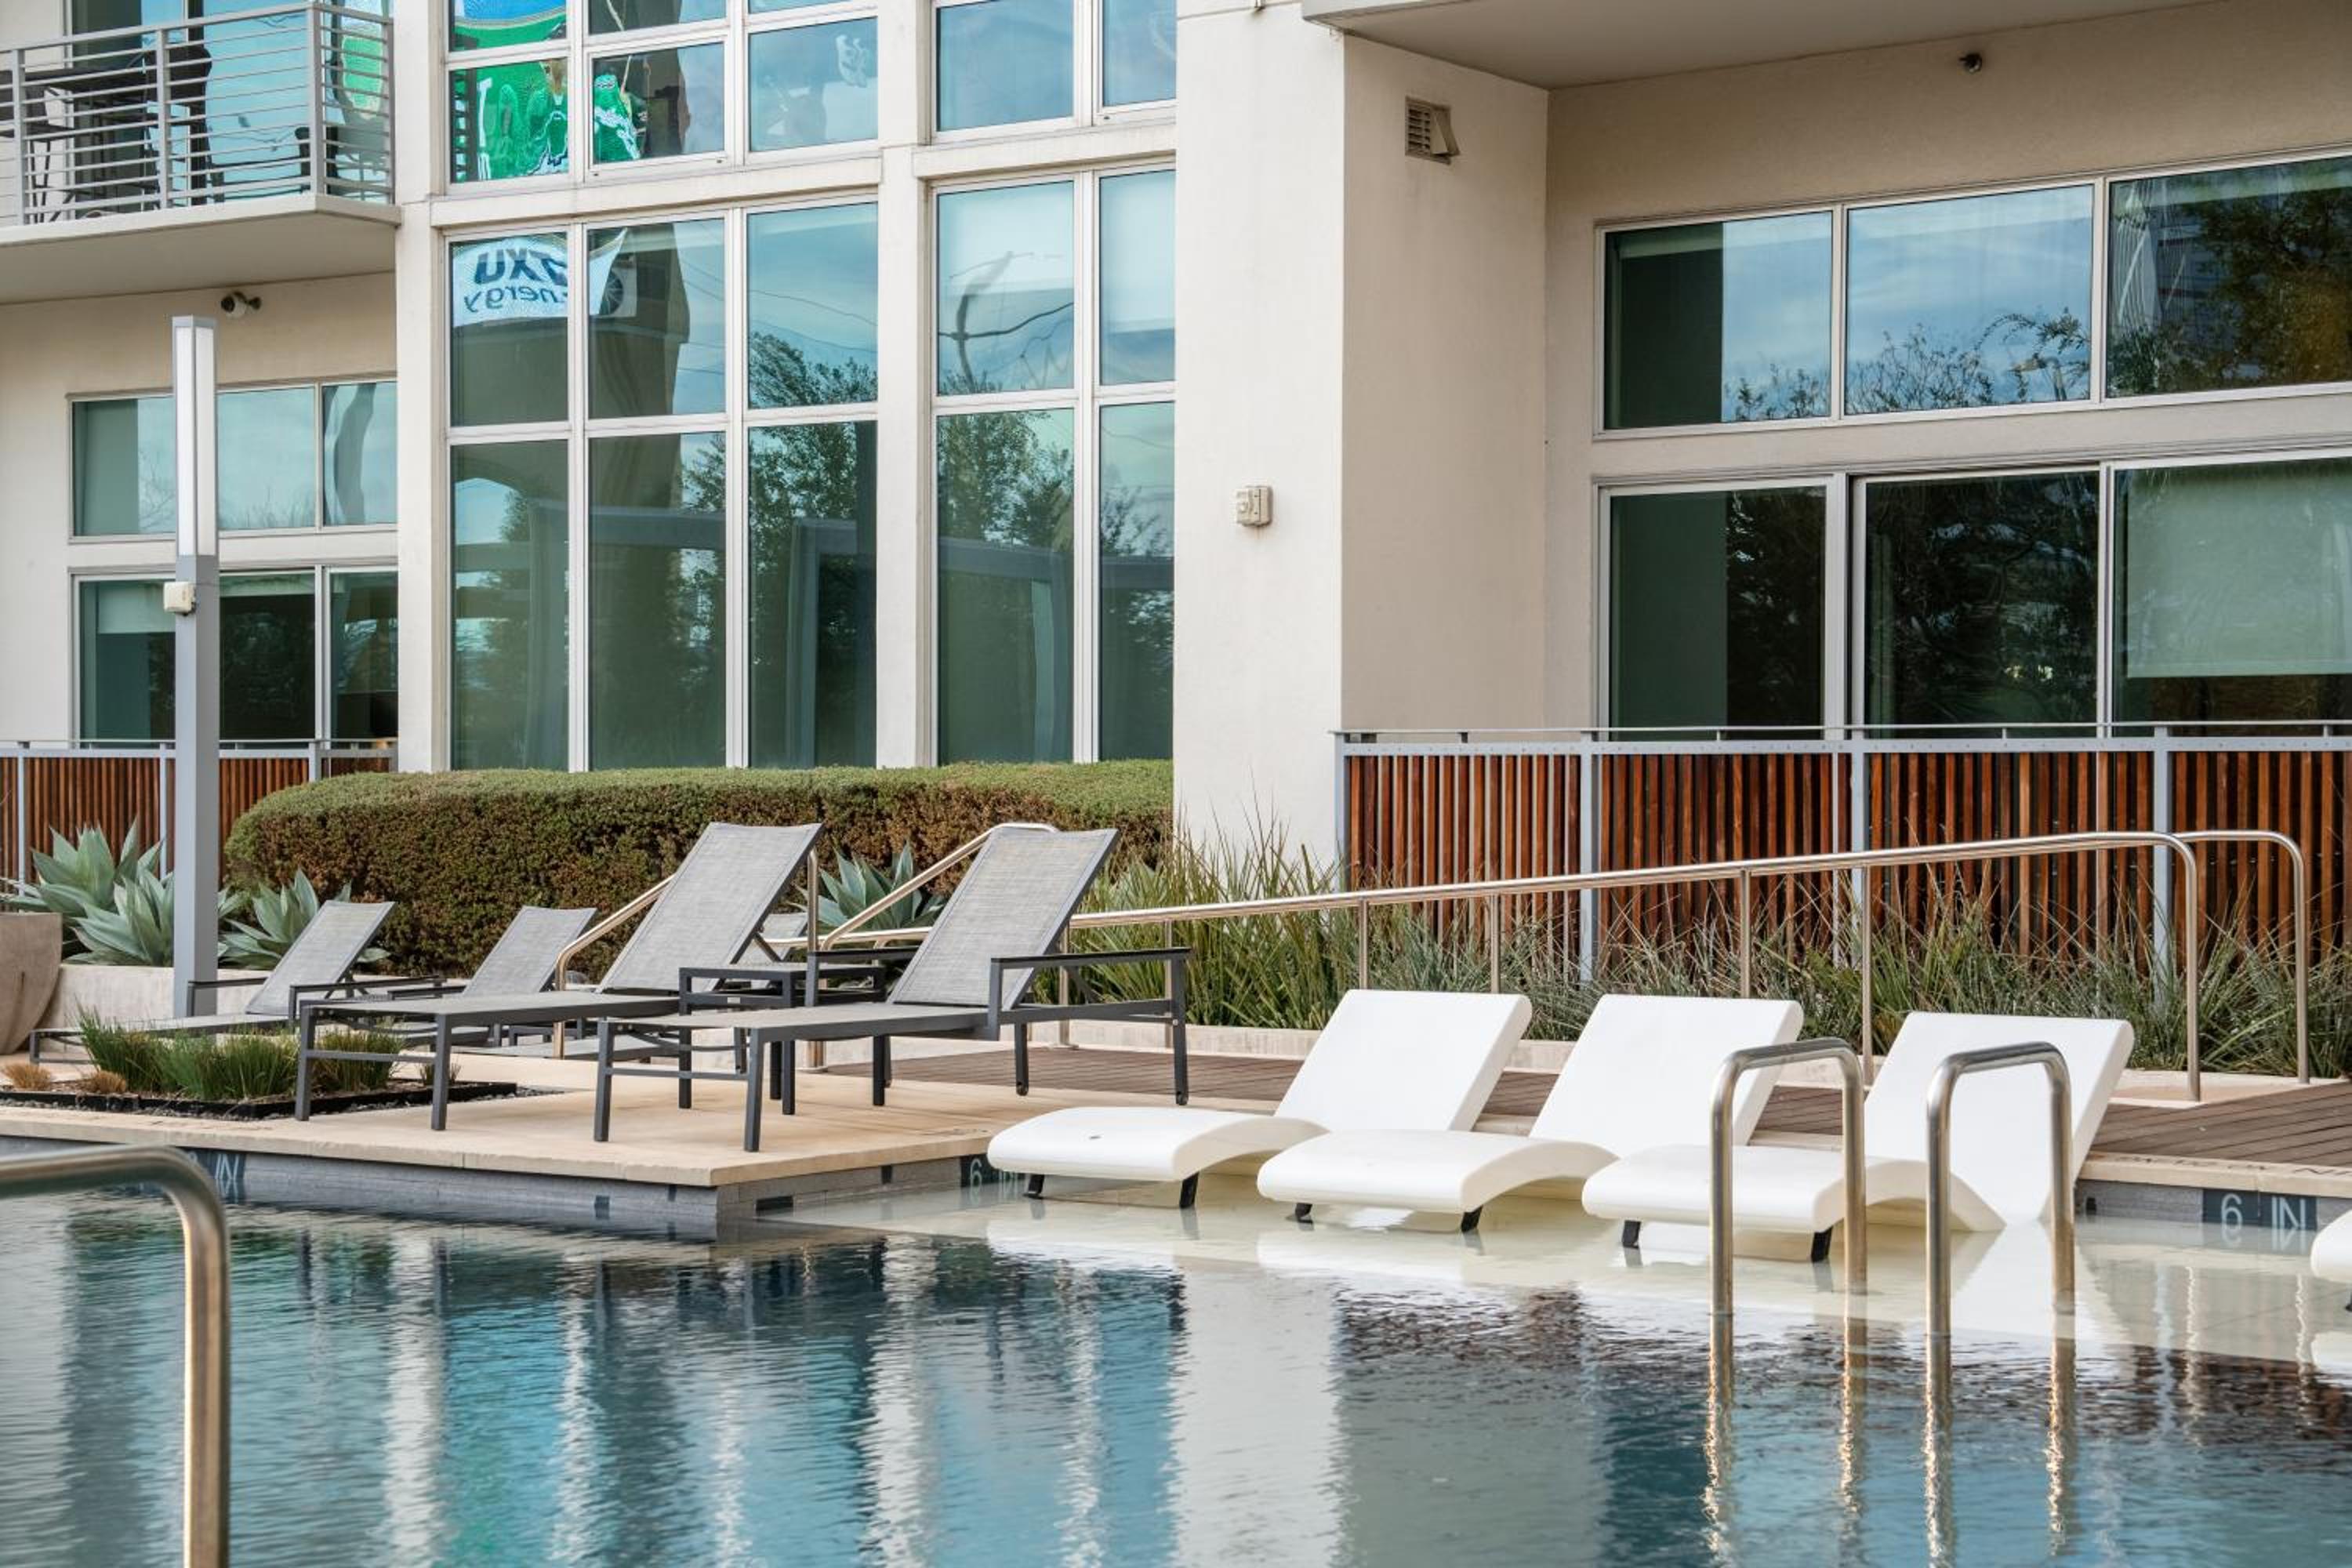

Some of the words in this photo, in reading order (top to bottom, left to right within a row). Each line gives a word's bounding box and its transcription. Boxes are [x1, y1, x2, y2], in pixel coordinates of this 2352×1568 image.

[969, 1158, 982, 1185] 6
[2220, 1192, 2243, 1231] 6
[2271, 1196, 2306, 1229] IN
